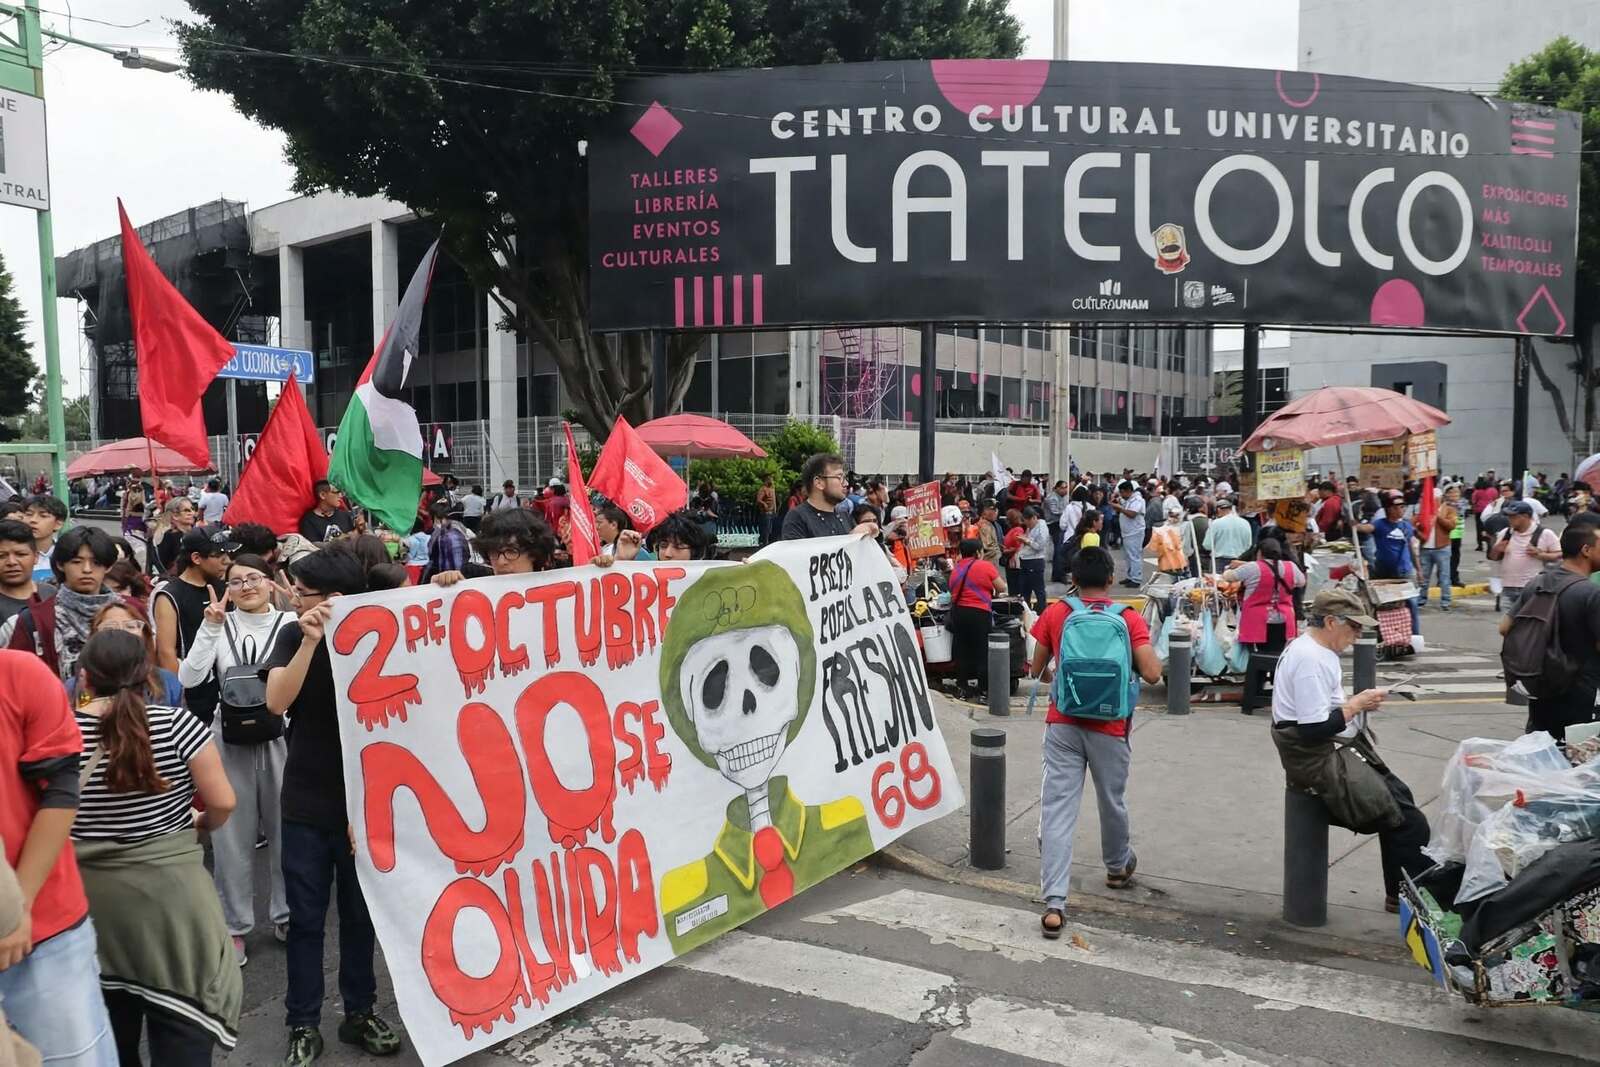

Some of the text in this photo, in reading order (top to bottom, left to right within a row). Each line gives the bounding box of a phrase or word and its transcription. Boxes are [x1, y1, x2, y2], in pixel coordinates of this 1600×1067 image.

[770, 103, 1470, 158] CENTRO CULTURAL UNIVERSITARIO
[630, 167, 718, 189] TALLERES
[0, 181, 46, 202] TRAL
[635, 189, 719, 214] LIBRERÍA
[1482, 184, 1568, 208] EXPOSICIONES
[749, 149, 1474, 276] TLATELOLCO
[1482, 206, 1510, 224] MÁS
[633, 220, 720, 240] EVENTOS
[1481, 232, 1552, 253] XALTILOLLI
[602, 246, 720, 268] CULTURALES
[1481, 255, 1562, 277] TEMPORALES
[809, 547, 853, 602] PREPA
[819, 580, 905, 645] POPULAR
[333, 567, 686, 732] 2 DE OCTUBRE
[821, 621, 934, 774] FRESNO
[360, 671, 673, 878] NO SE
[871, 741, 943, 831] 68
